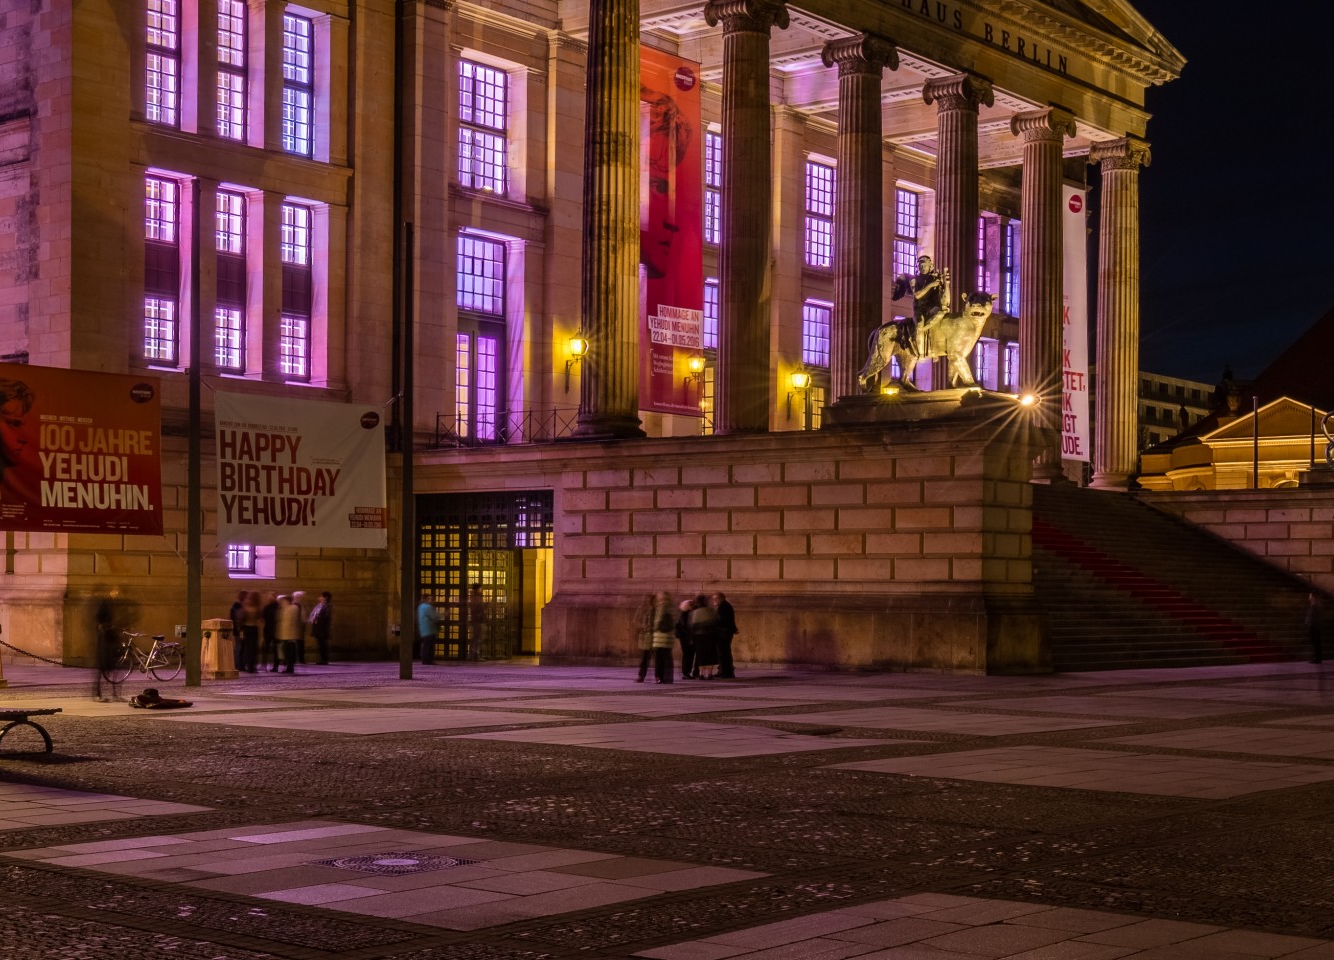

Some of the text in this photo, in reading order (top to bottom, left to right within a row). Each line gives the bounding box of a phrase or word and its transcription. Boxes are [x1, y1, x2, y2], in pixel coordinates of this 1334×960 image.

[984, 22, 1068, 74] BERLIN
[650, 317, 700, 335] YEHUDI MENUHIN
[658, 305, 699, 322] HOMMAGE AN
[40, 423, 153, 456] 100 JAHRE
[219, 429, 302, 465] HAPPY
[38, 451, 128, 482] YEHUDI
[220, 461, 341, 497] BIRTHDAY
[40, 480, 154, 511] MENUHIN.
[220, 493, 316, 526] YEHUDI!
